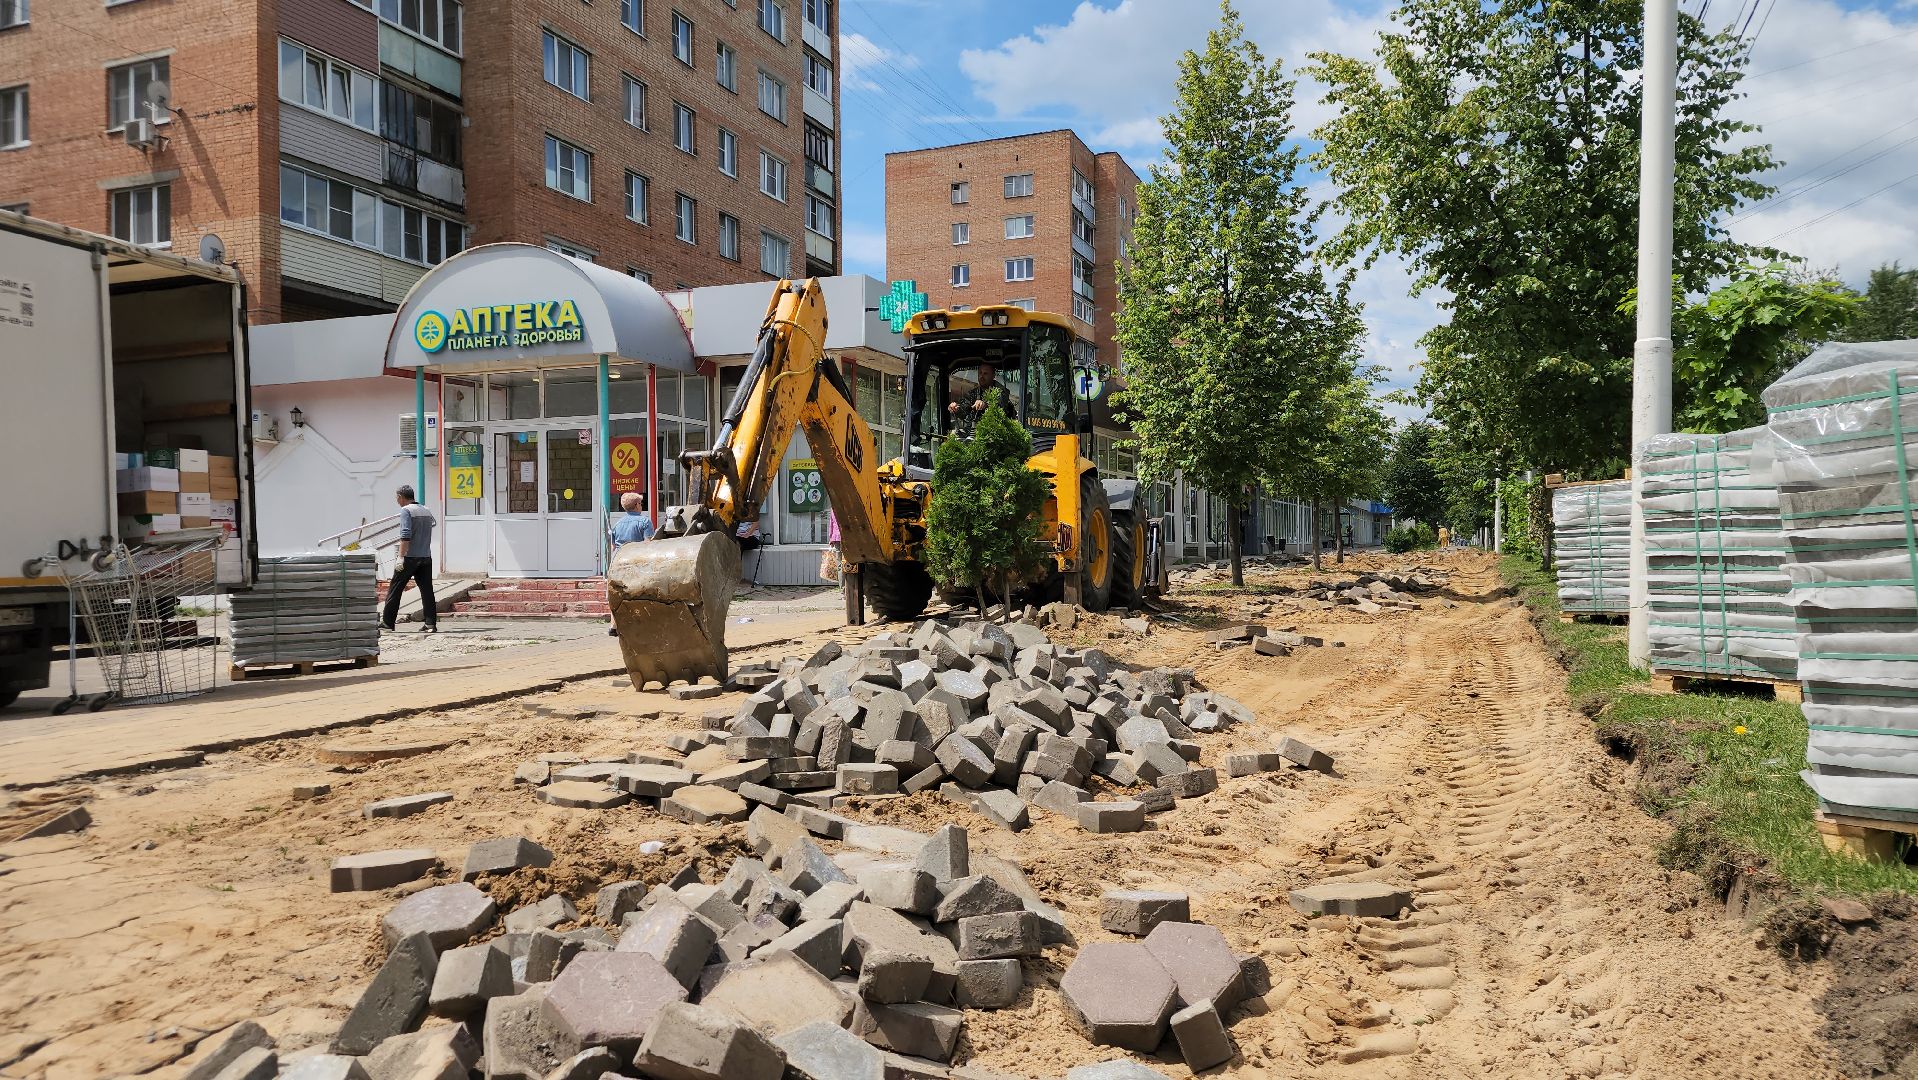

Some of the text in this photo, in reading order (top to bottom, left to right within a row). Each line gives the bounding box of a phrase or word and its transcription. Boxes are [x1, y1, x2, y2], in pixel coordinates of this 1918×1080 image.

[895, 300, 909, 313] 24
[449, 300, 581, 336] АПТЕКА
[448, 328, 581, 350] ПЛАНЕТА ЗДОРОВЬЯ
[1080, 376, 1094, 394] F
[454, 446, 479, 454] АПТЕКА
[456, 473, 475, 490] 24
[612, 477, 639, 485] НИЗКИЕ
[616, 484, 636, 492] ЦЕНЫ
